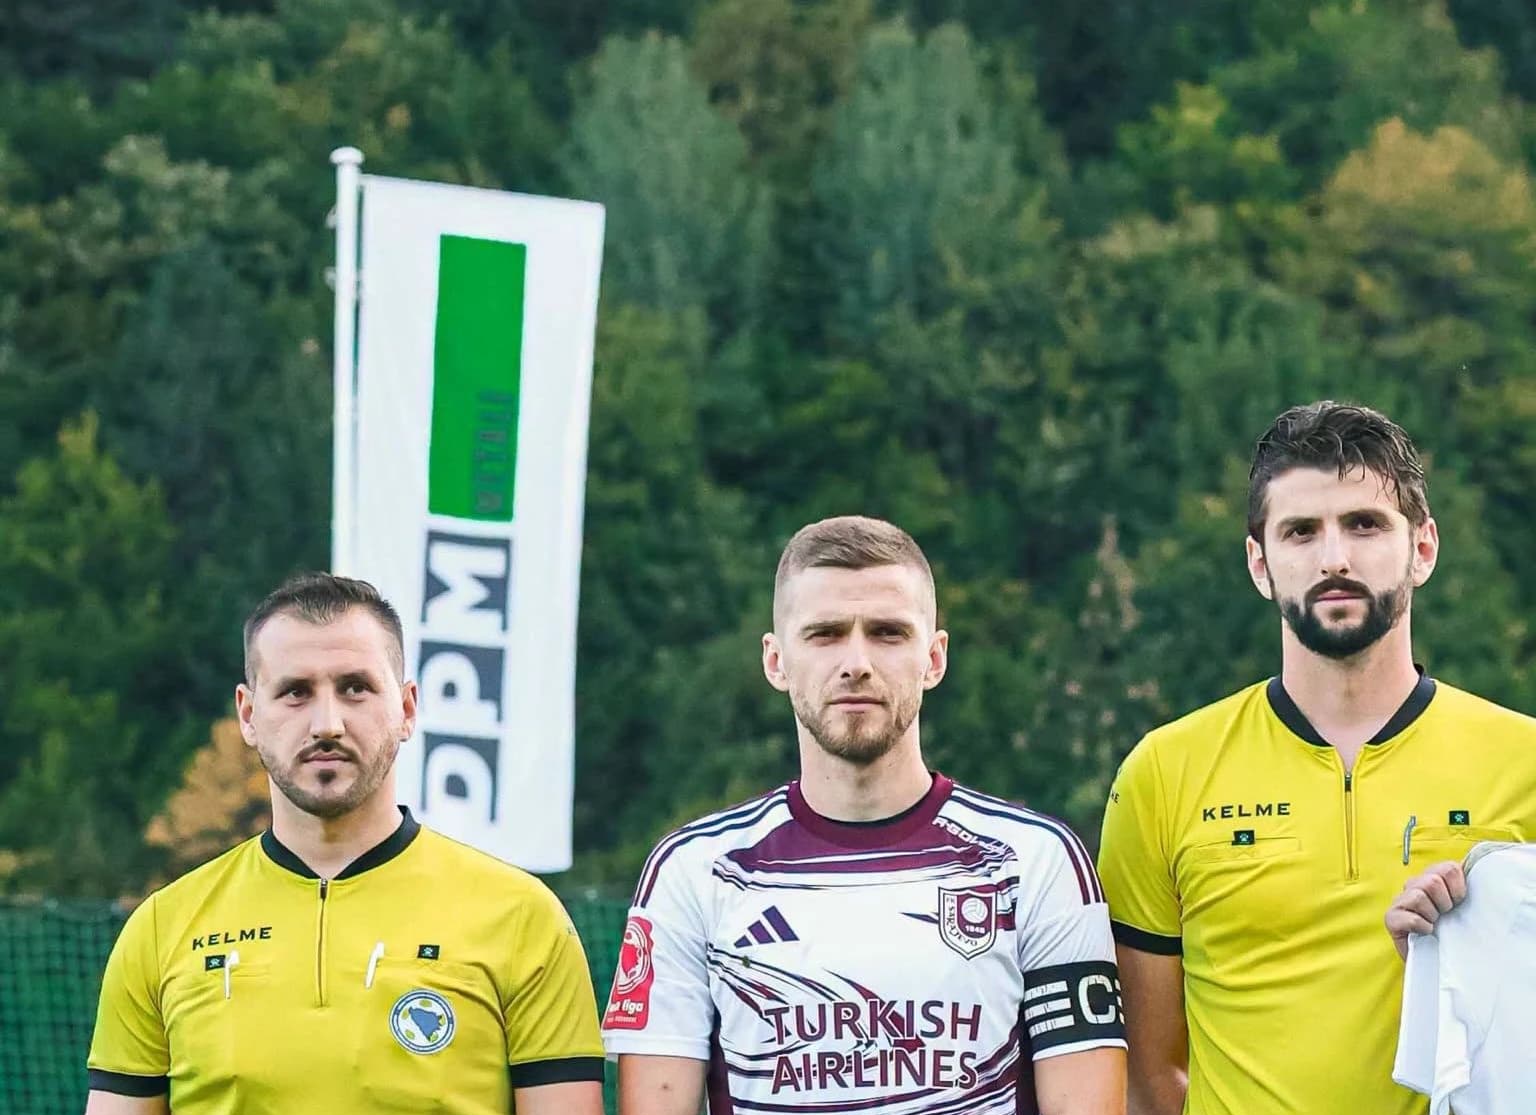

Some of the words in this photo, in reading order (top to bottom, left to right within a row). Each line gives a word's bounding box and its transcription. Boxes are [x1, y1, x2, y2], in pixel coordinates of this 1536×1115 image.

[418, 531, 511, 823] DPM
[1202, 802, 1291, 822] KELME
[192, 926, 273, 951] KELME
[764, 999, 983, 1046] TURKISH
[1078, 974, 1116, 1025] C
[771, 1049, 978, 1095] AIRLINES
